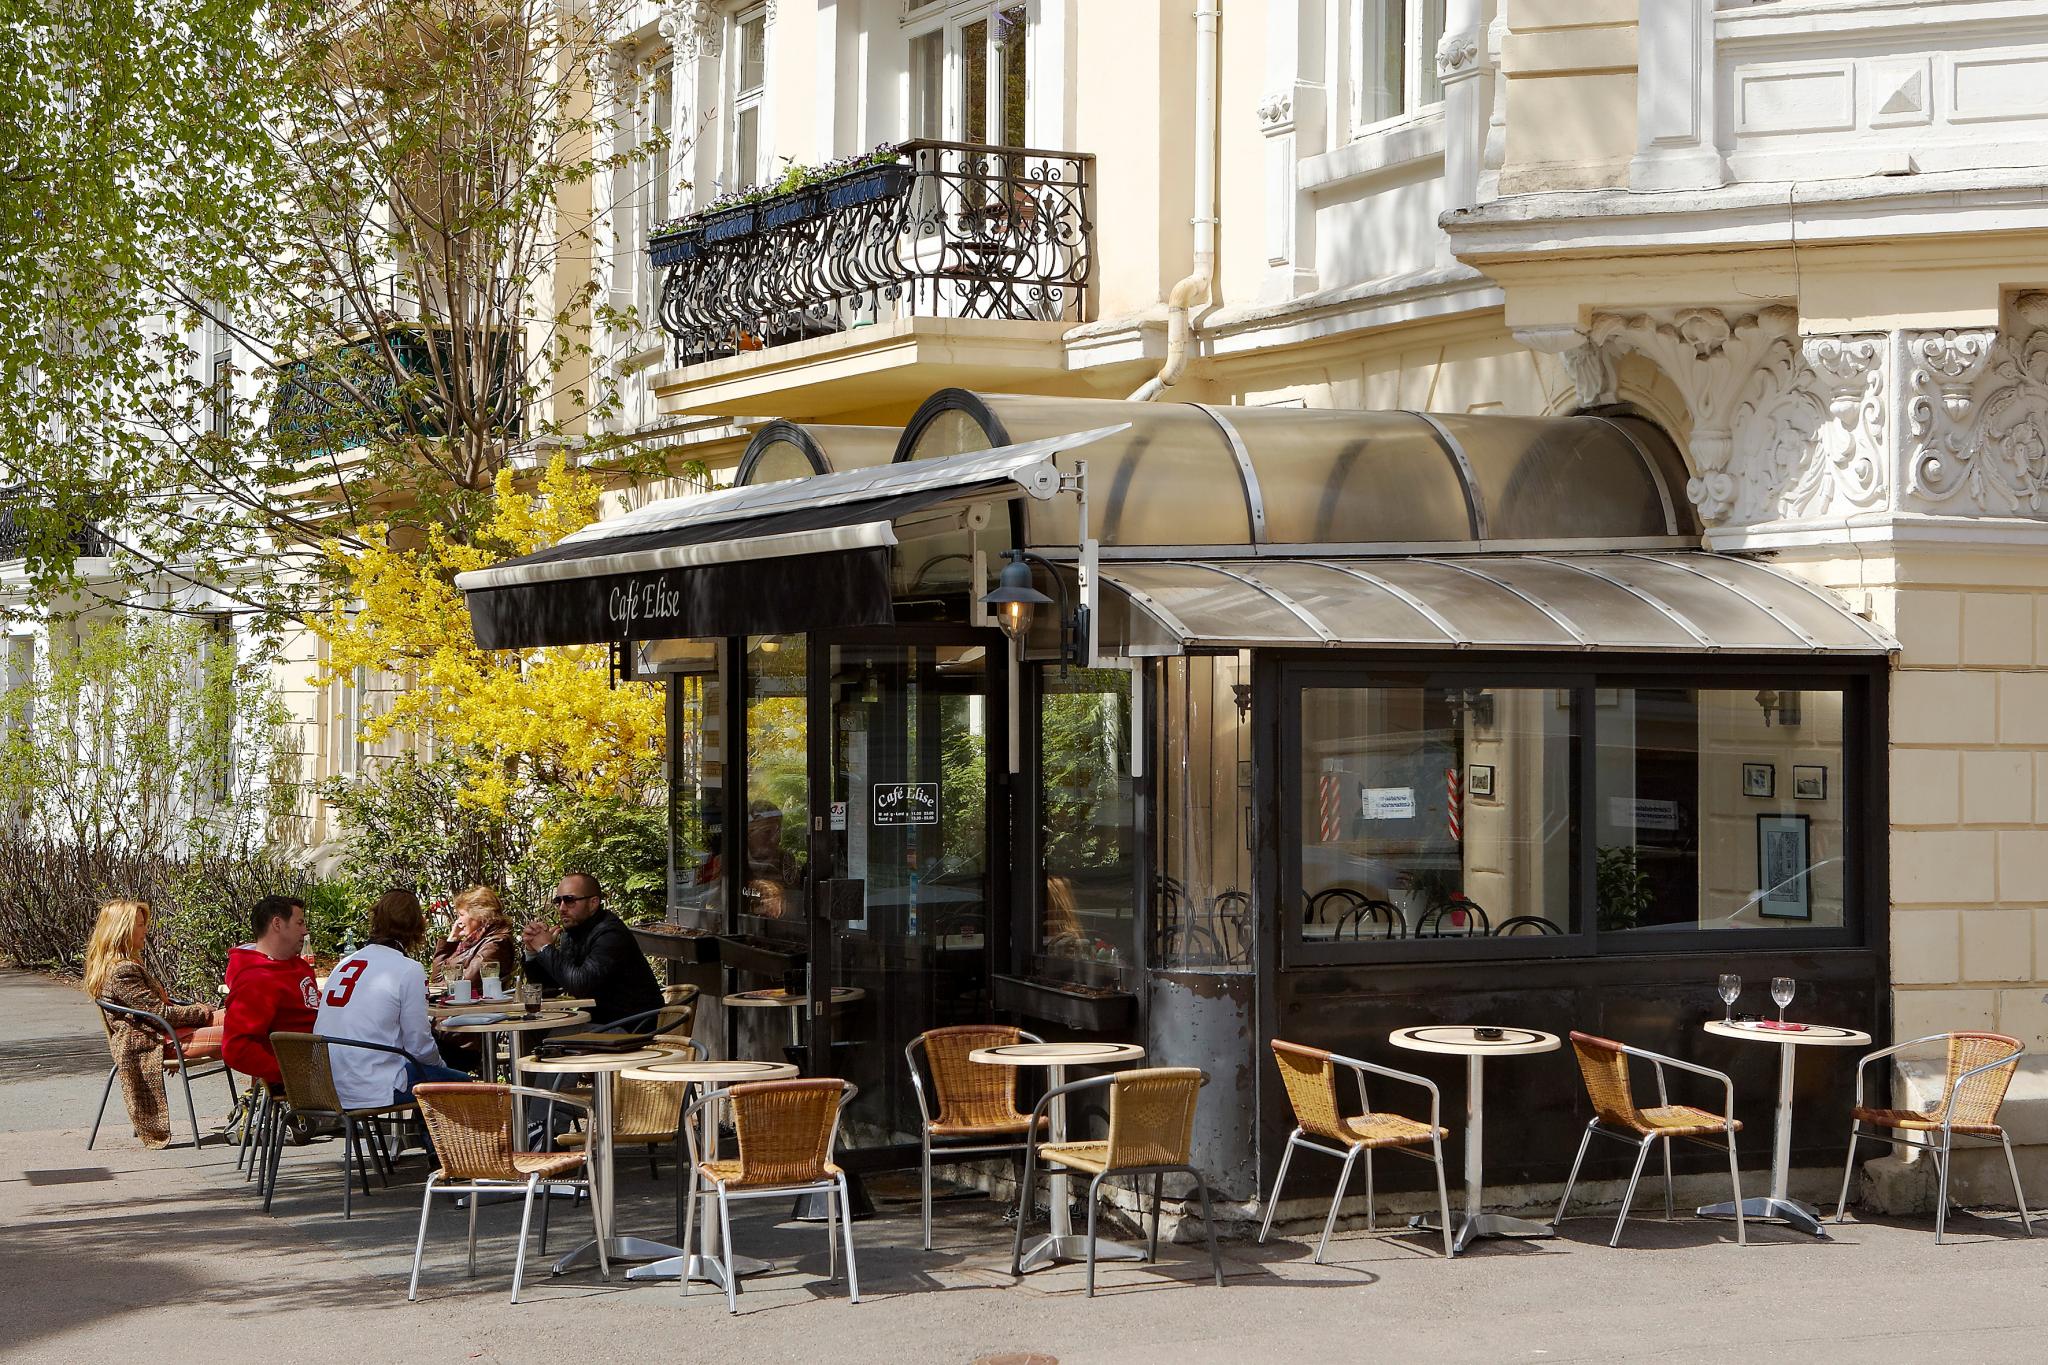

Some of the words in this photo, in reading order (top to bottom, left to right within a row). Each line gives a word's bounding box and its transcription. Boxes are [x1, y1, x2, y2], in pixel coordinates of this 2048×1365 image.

[609, 579, 639, 636] Café
[642, 576, 680, 619] Elise
[878, 786, 904, 807] Café
[905, 786, 935, 807] Elise
[325, 959, 369, 1008] 3
